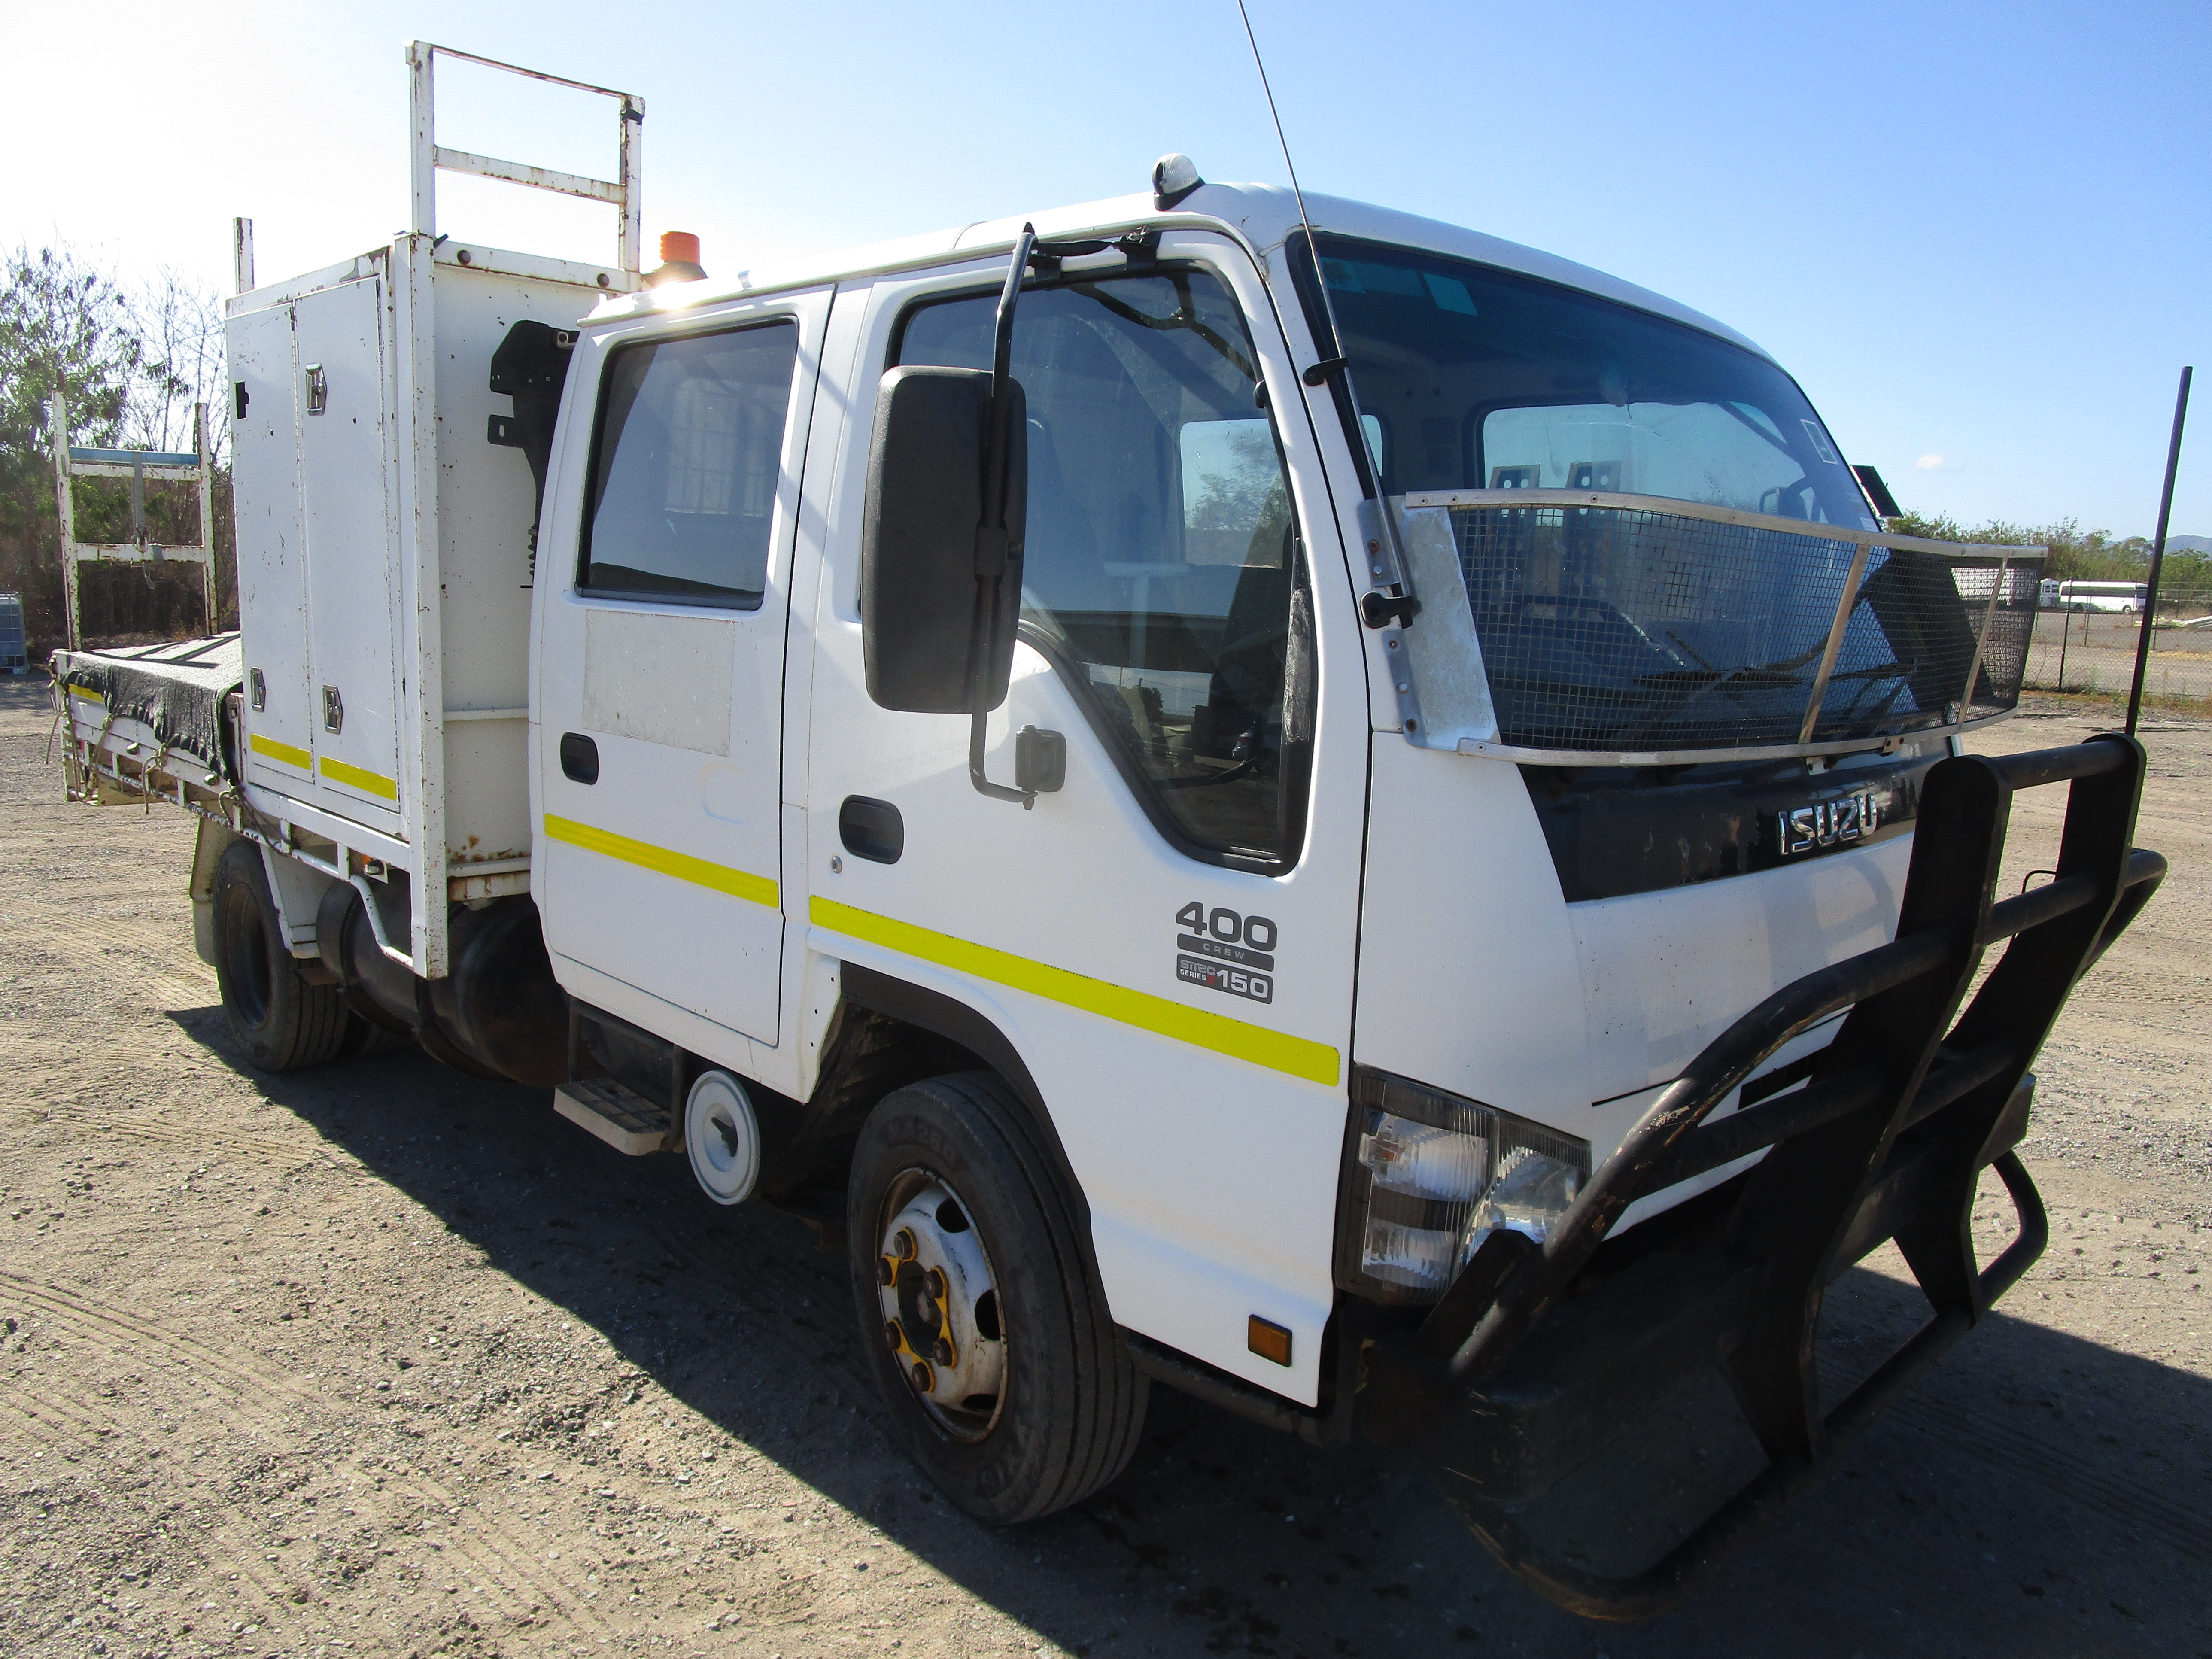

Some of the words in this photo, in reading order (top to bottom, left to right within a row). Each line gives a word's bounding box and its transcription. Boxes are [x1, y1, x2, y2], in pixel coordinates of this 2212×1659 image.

[1777, 793, 1878, 856] ISUZU
[1176, 901, 1278, 952] 400
[1203, 943, 1245, 960] CREW
[1179, 968, 1207, 981] SERIES
[1216, 969, 1269, 999] 150
